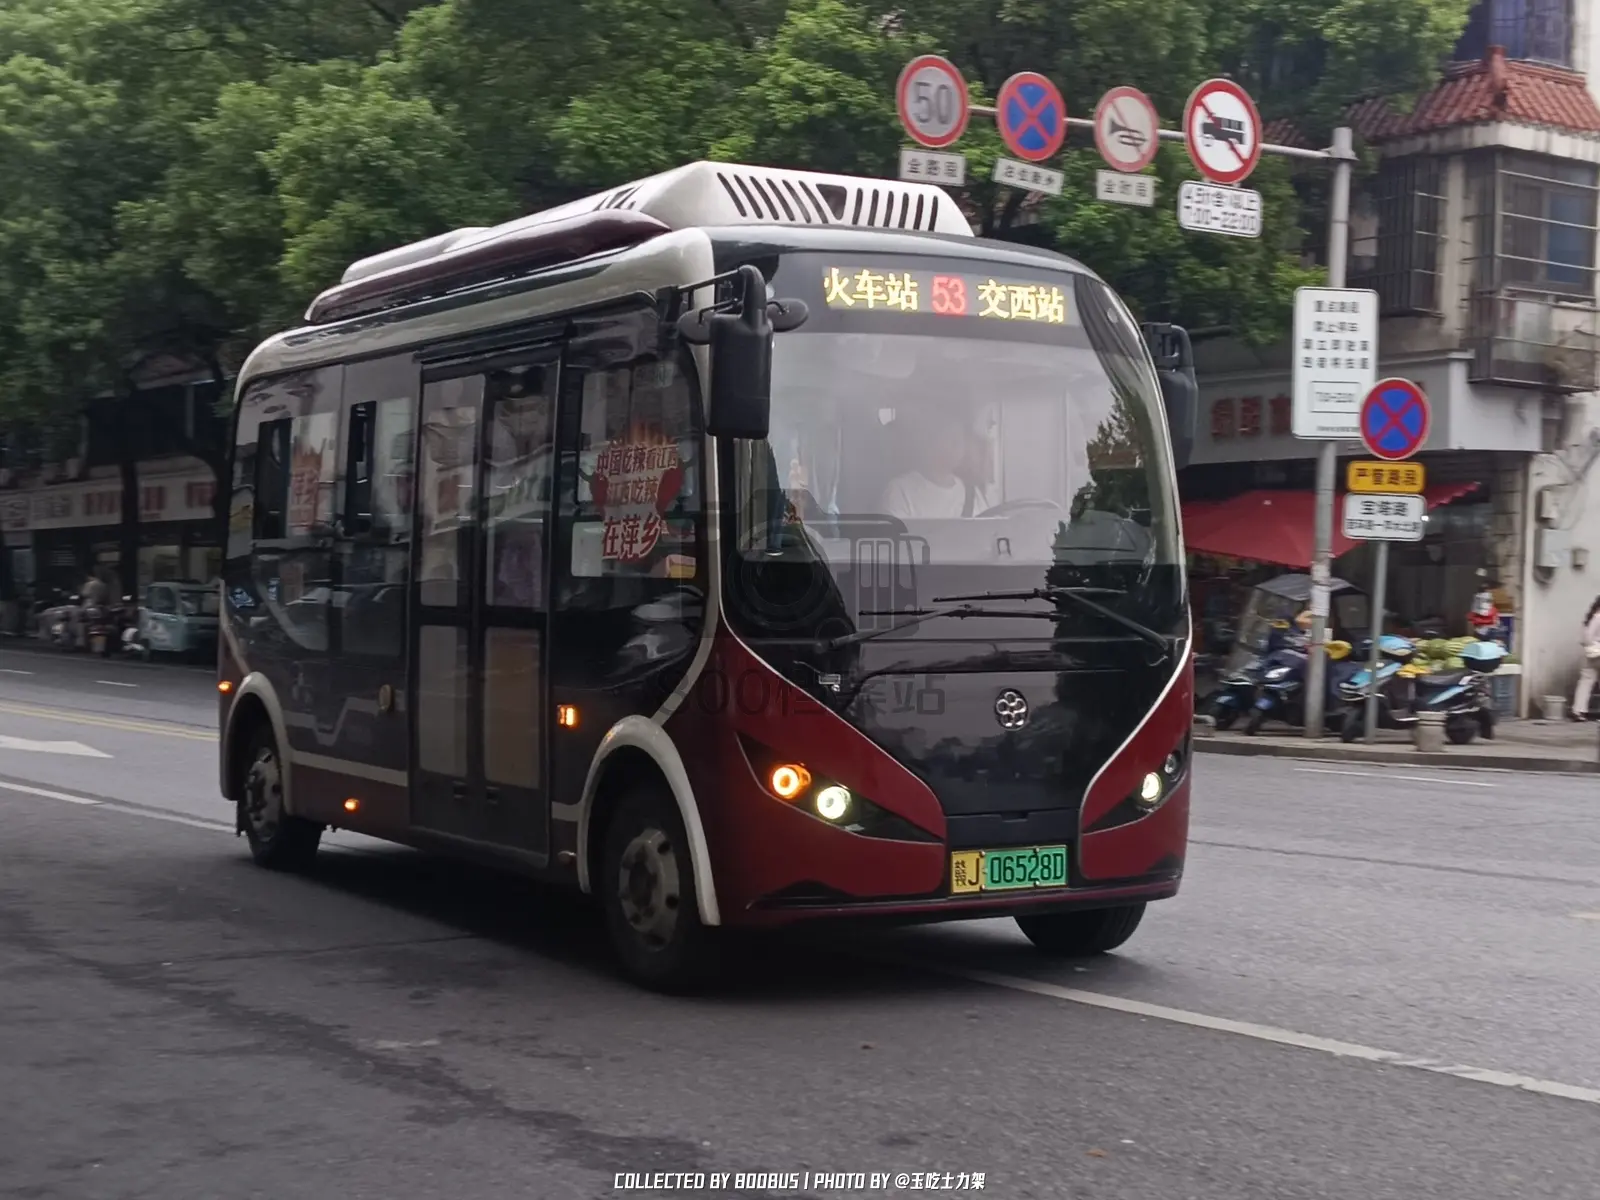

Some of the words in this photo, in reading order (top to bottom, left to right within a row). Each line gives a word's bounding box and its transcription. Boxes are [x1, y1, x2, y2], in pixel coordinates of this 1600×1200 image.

[912, 80, 953, 125] 50
[824, 267, 919, 310] 火车站
[931, 274, 968, 315] 53
[977, 279, 1064, 323] 交西站
[602, 514, 662, 558] 在萍乡
